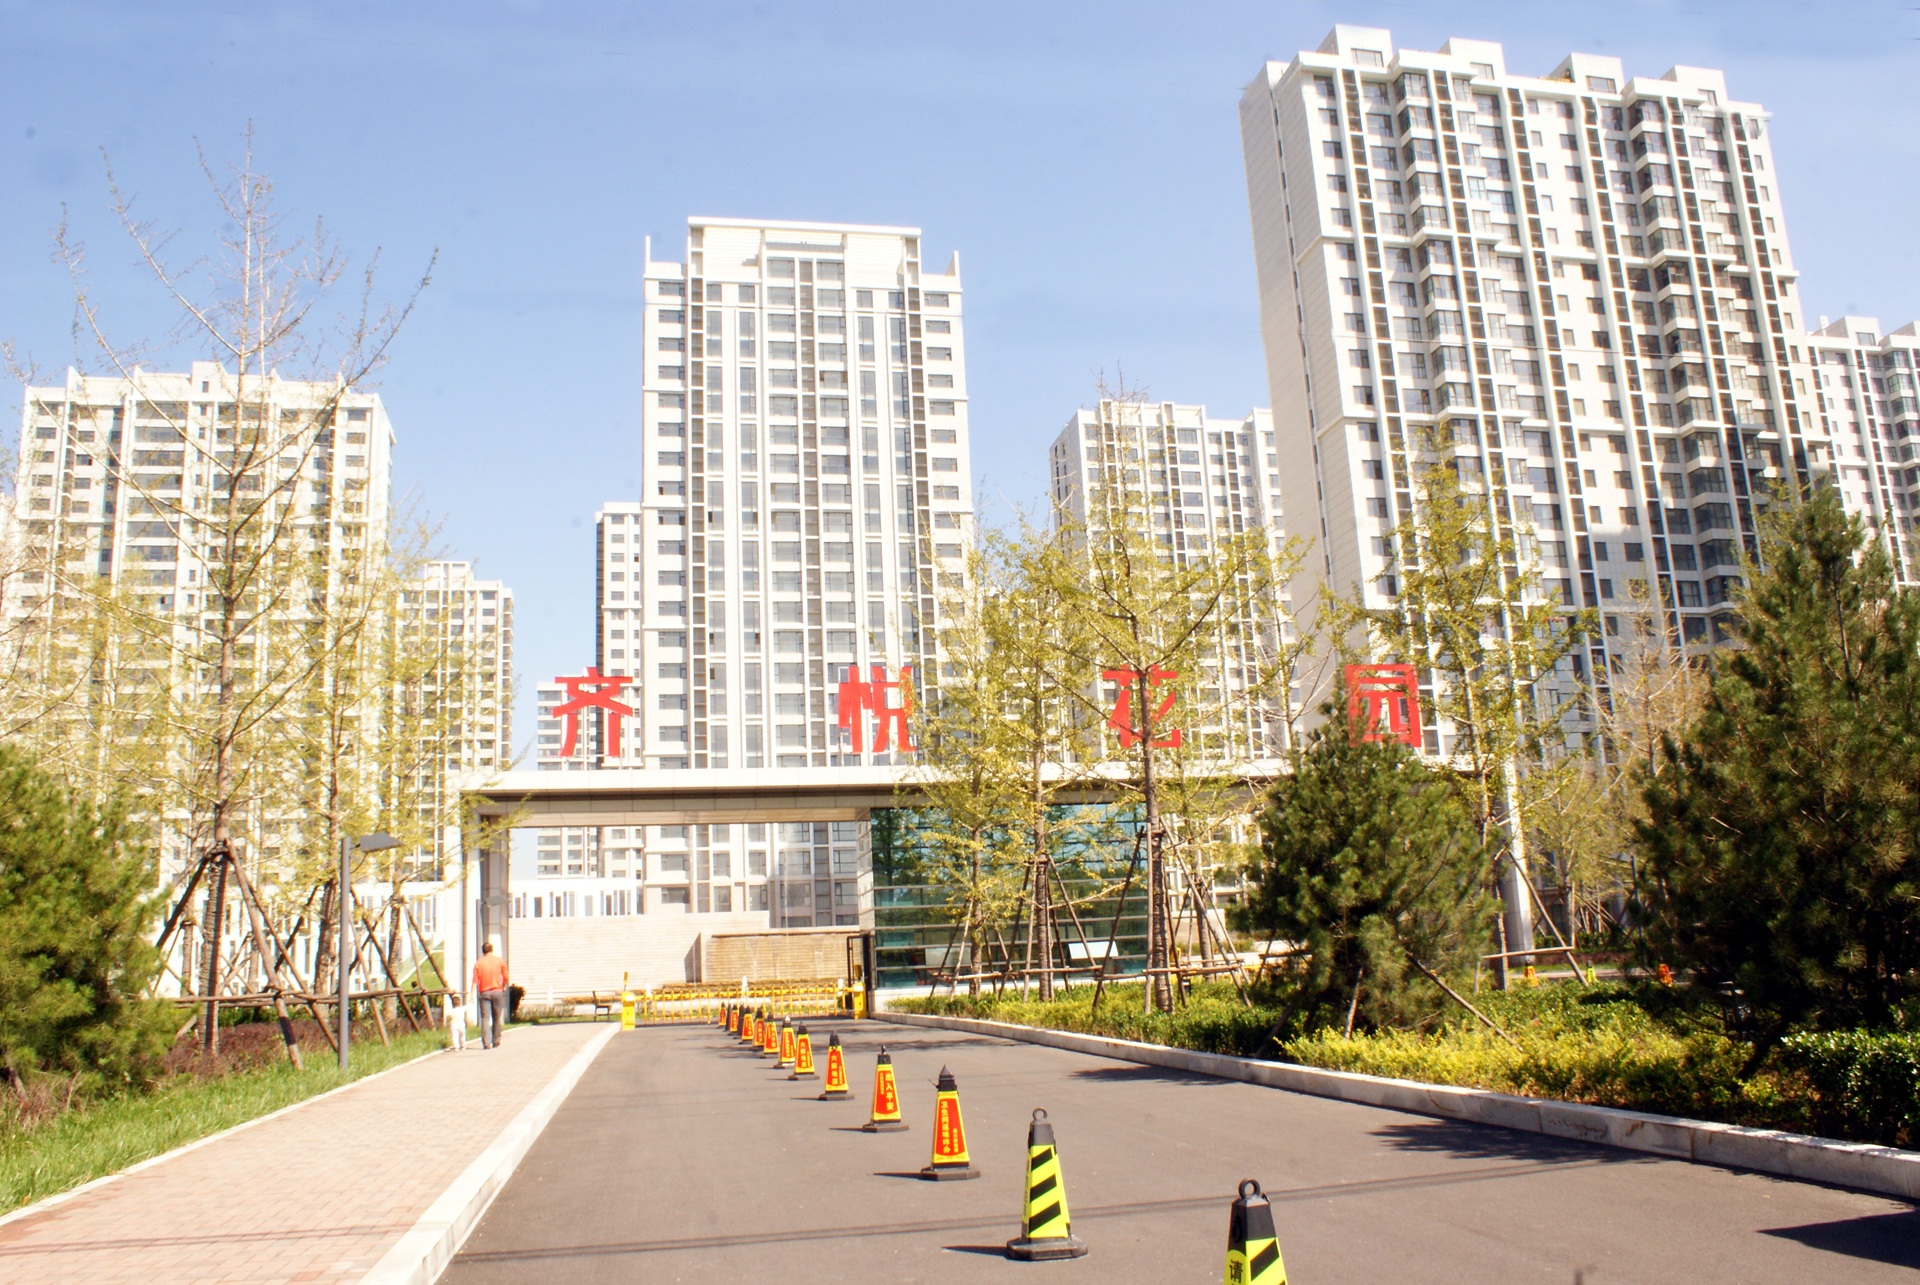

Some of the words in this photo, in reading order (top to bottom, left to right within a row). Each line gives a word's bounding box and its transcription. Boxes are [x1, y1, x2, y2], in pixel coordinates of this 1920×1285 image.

[552, 663, 1421, 757] 齐悦花园
[885, 1073, 894, 1111] 出入平安
[1229, 1259, 1243, 1285] 请
